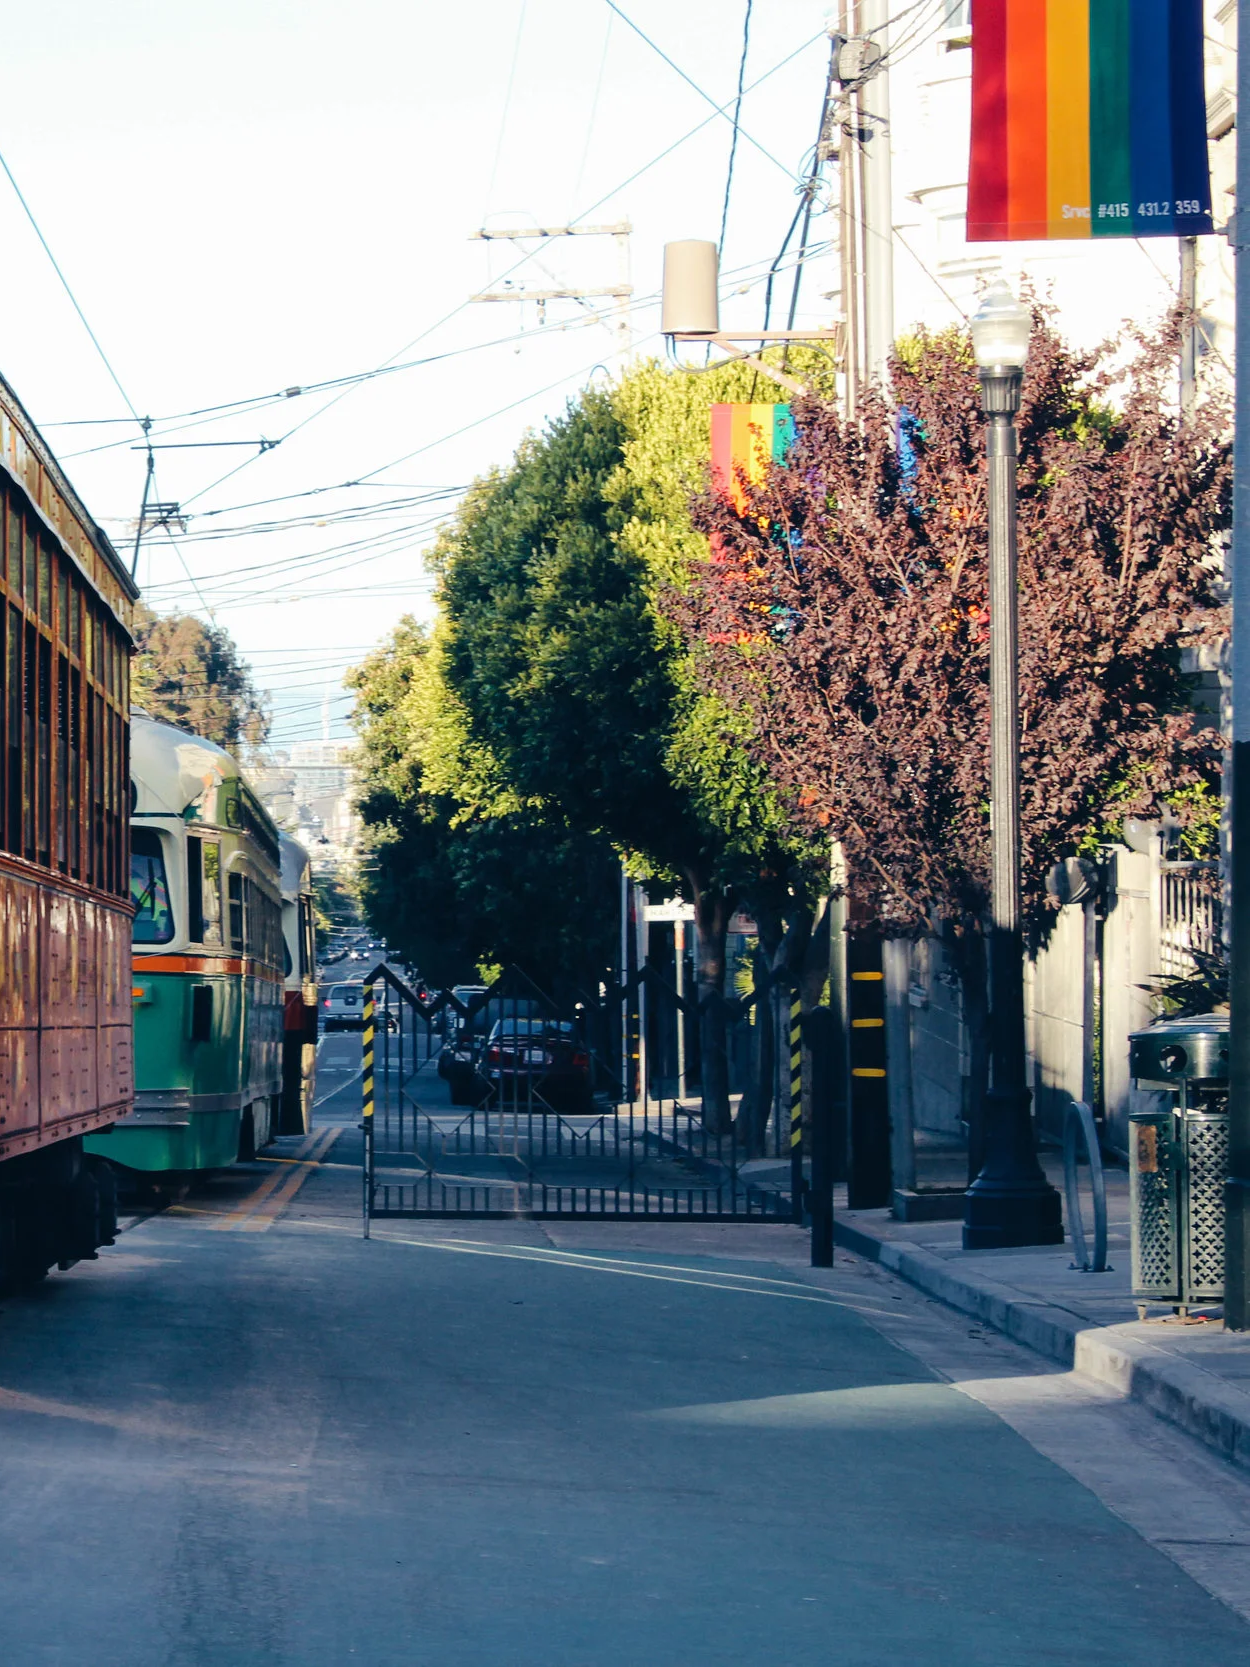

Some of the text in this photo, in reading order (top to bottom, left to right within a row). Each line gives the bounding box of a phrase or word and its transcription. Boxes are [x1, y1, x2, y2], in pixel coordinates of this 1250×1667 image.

[1098, 203, 1129, 218] #415
[1138, 202, 1170, 216] 431.2
[1175, 200, 1200, 214] 359
